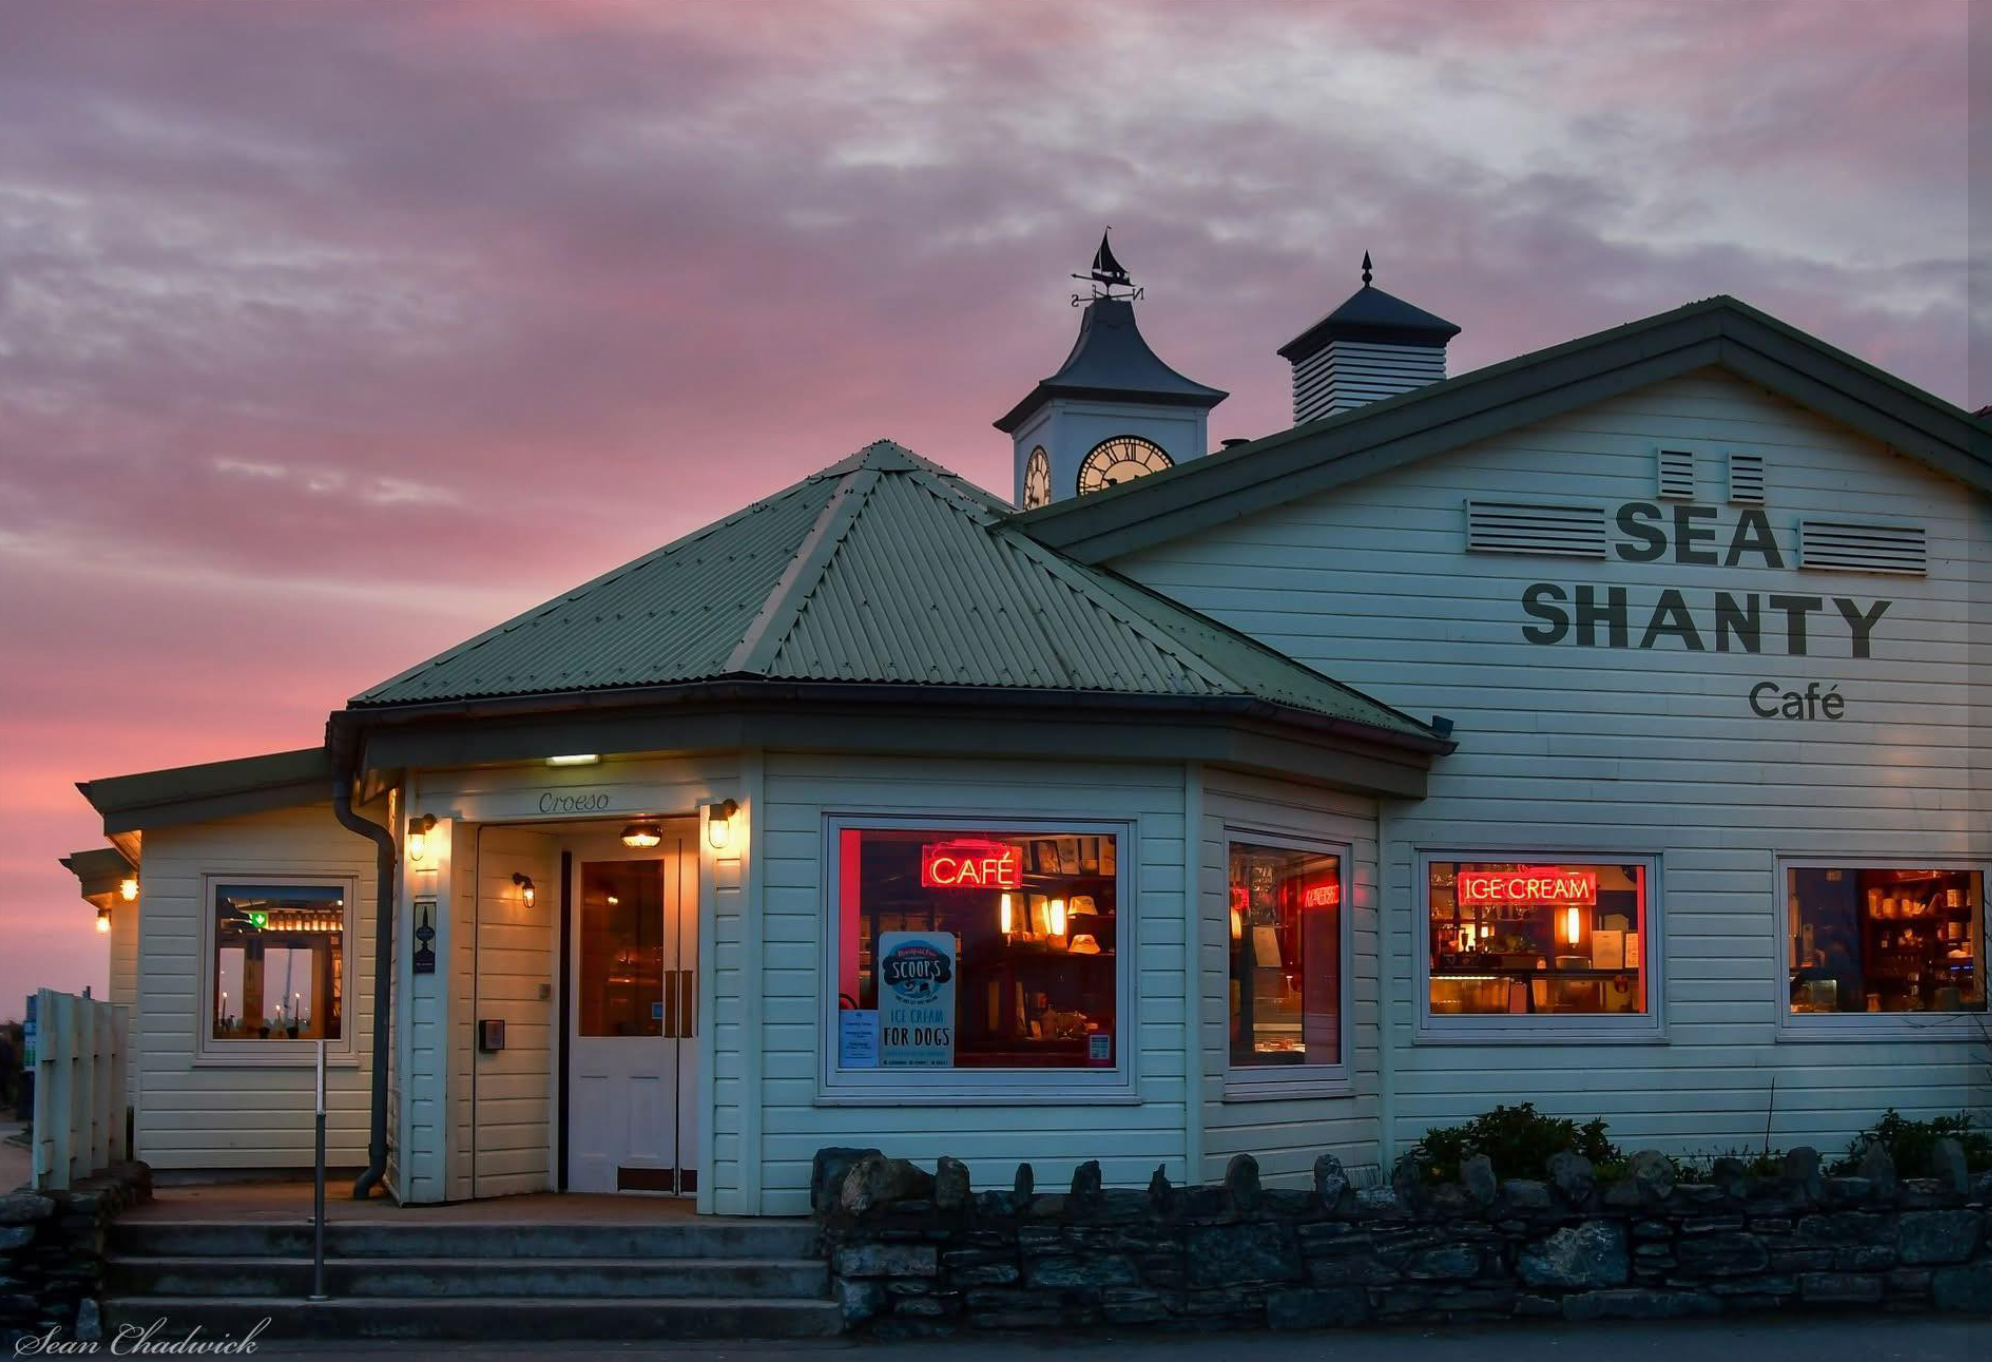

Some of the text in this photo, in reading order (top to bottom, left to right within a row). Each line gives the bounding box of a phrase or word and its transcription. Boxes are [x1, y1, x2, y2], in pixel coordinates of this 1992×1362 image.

[1615, 502, 1784, 569] SEA
[1521, 583, 1893, 659] SHANTY
[1748, 681, 1845, 720] Café
[539, 792, 609, 813] Croeso
[931, 851, 1014, 885] CAFÉ
[1464, 878, 1589, 899] ICE CREAM
[883, 1027, 950, 1047] FOR DOGS
